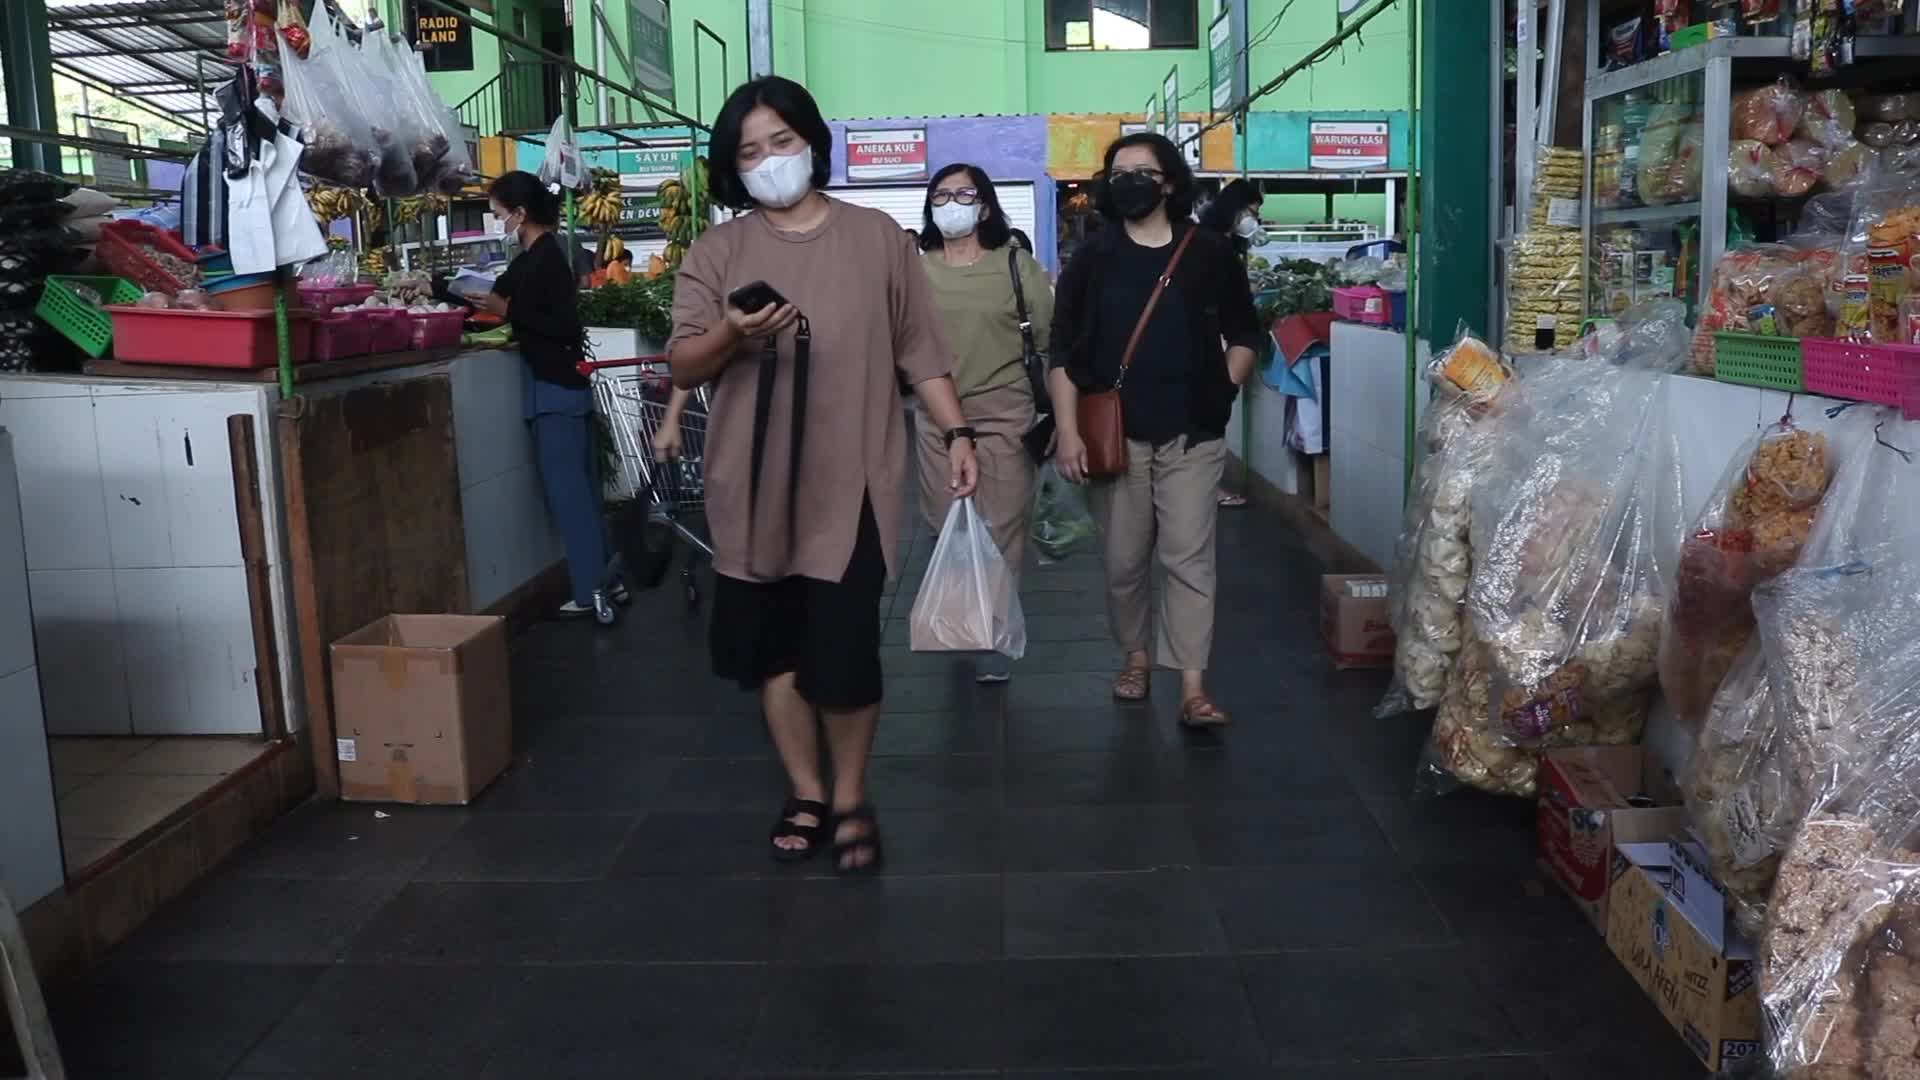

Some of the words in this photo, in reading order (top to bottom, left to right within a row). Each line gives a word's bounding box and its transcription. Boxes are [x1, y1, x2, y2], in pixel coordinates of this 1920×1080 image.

[419, 17, 458, 29] RADIO
[422, 31, 457, 42] LAND
[1315, 136, 1358, 144] WARUNG
[1360, 135, 1383, 144] NASI
[856, 144, 892, 152] ANEKA
[894, 143, 916, 152] KUE
[635, 152, 678, 161] SAYUR
